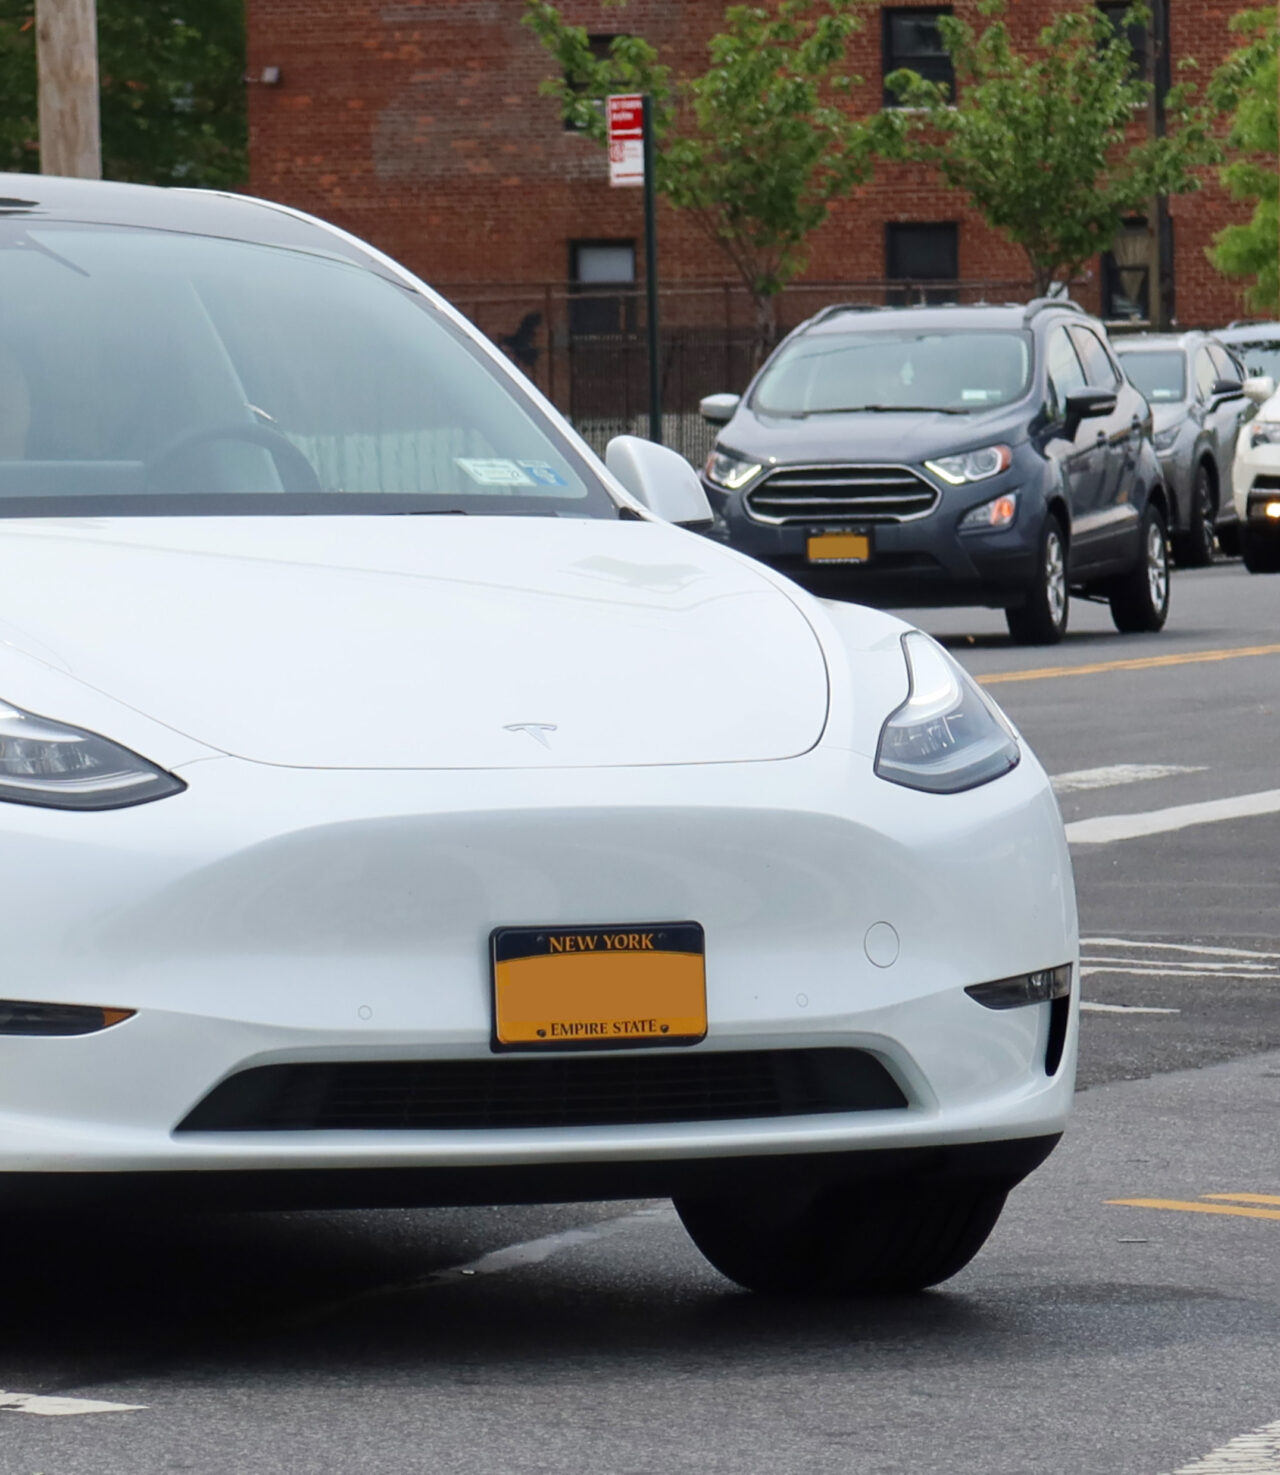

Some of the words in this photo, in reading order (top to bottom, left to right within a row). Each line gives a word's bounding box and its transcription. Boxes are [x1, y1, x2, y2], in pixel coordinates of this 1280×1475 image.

[549, 936, 598, 953] NEW
[603, 933, 654, 950] YORK
[551, 1022, 608, 1037] EMPIRE
[612, 1019, 657, 1034] STATE
